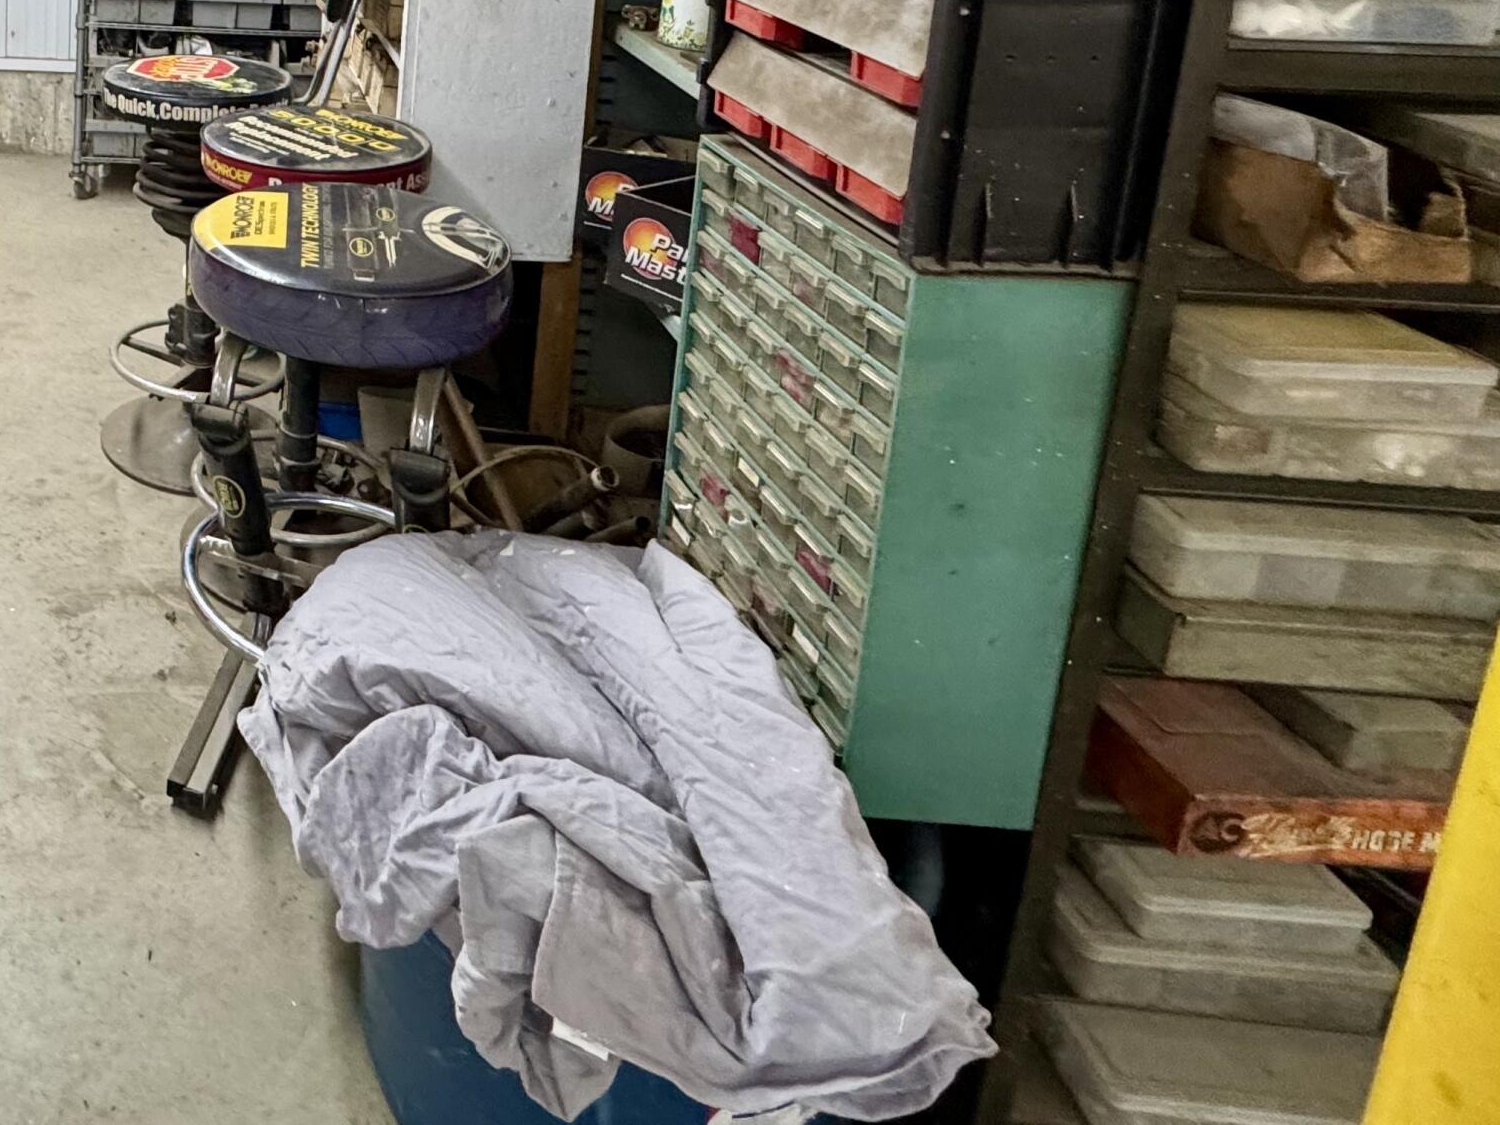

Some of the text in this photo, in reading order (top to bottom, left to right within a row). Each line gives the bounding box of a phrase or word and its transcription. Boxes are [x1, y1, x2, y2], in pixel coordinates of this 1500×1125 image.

[231, 195, 254, 239] MONROE
[301, 182, 320, 268] TWIN TECHNOLOGY
[625, 246, 688, 285] Mast
